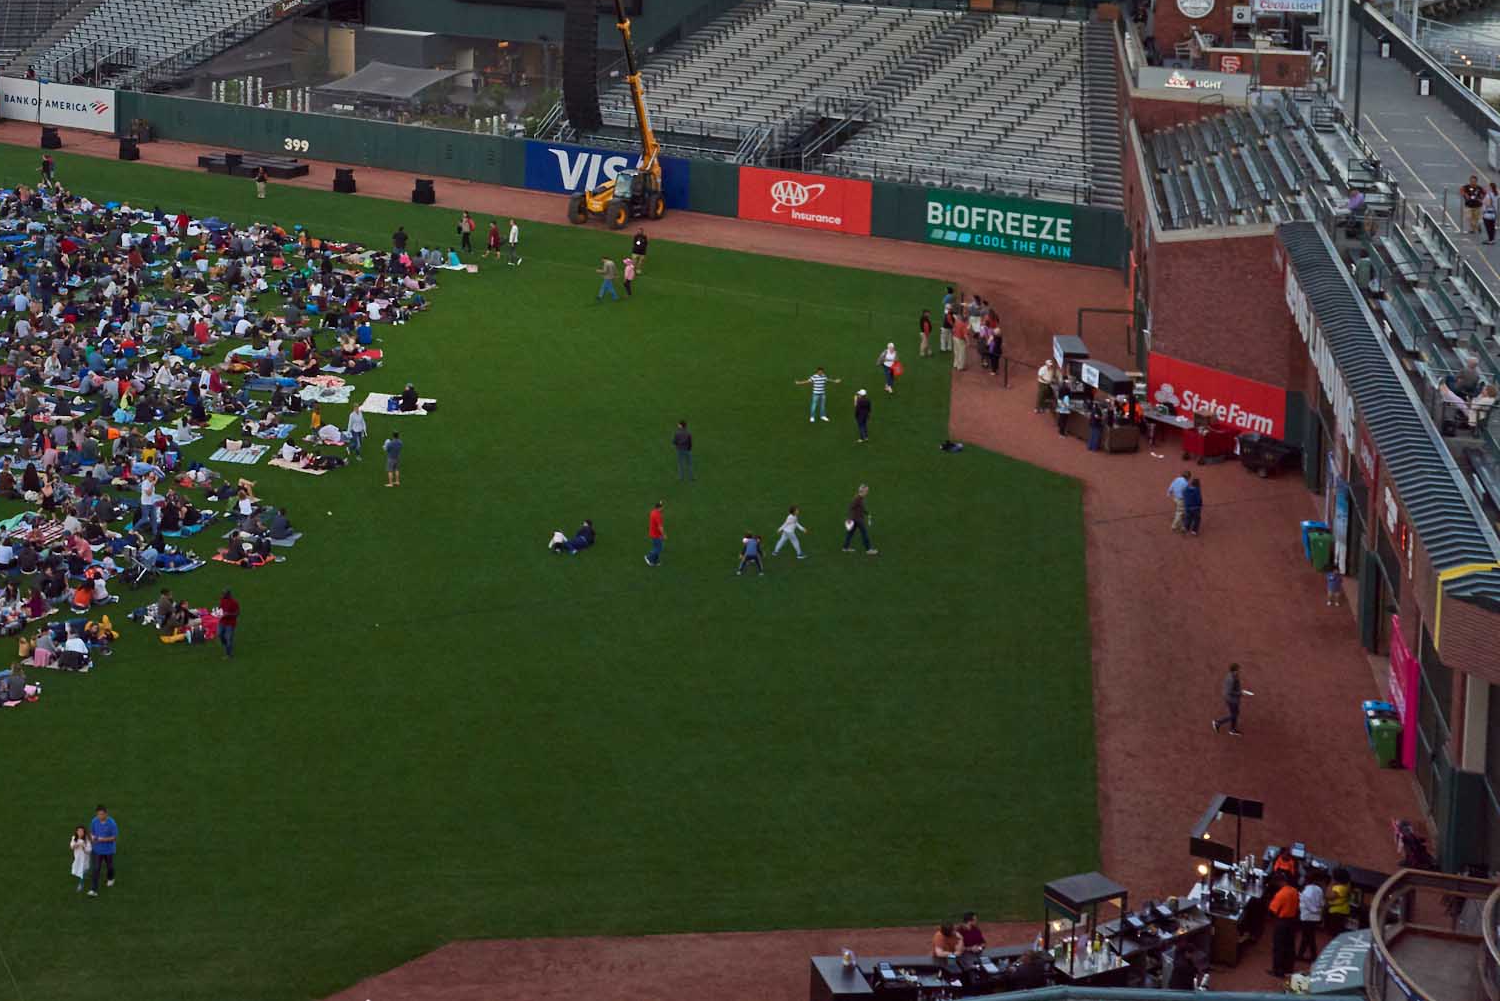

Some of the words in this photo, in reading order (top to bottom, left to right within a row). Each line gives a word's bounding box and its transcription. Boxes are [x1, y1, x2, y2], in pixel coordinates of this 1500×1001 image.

[1291, 2, 1318, 10] LIGHT
[1196, 79, 1222, 90] LIGHT
[4, 94, 29, 106] BANK
[31, 96, 43, 107] OF
[45, 100, 87, 112] AMERICA
[284, 137, 309, 152] 399
[548, 149, 644, 191] VIS
[774, 183, 807, 204] AAA
[791, 209, 841, 226] Insurance
[974, 233, 1008, 250] COOL
[1012, 239, 1037, 254] THE
[1041, 243, 1072, 258] PAIN
[1325, 933, 1373, 985] Alaska
